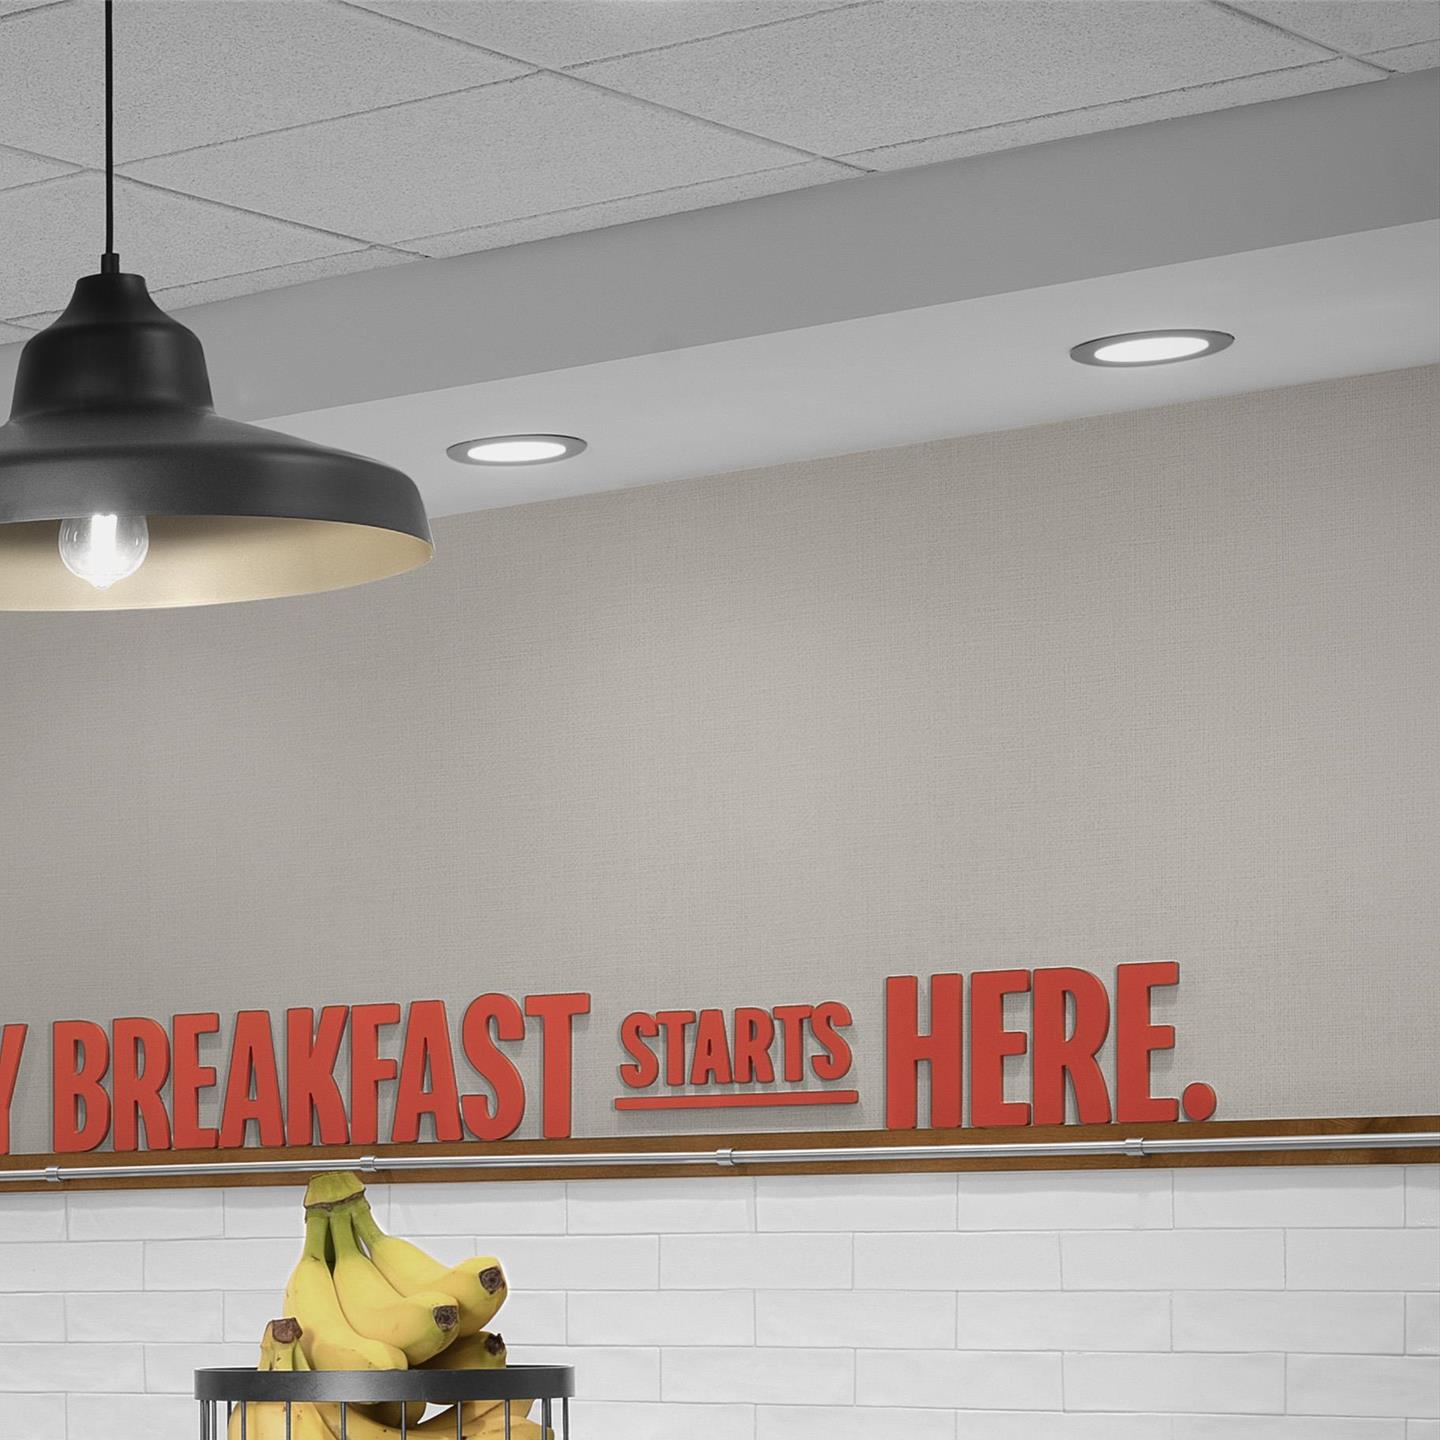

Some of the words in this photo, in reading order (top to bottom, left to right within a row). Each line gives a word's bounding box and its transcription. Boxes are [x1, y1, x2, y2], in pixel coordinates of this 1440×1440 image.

[53, 992, 590, 1153] BREAKFAST
[620, 1001, 853, 1088] STARTS
[886, 962, 1217, 1130] HERE.
